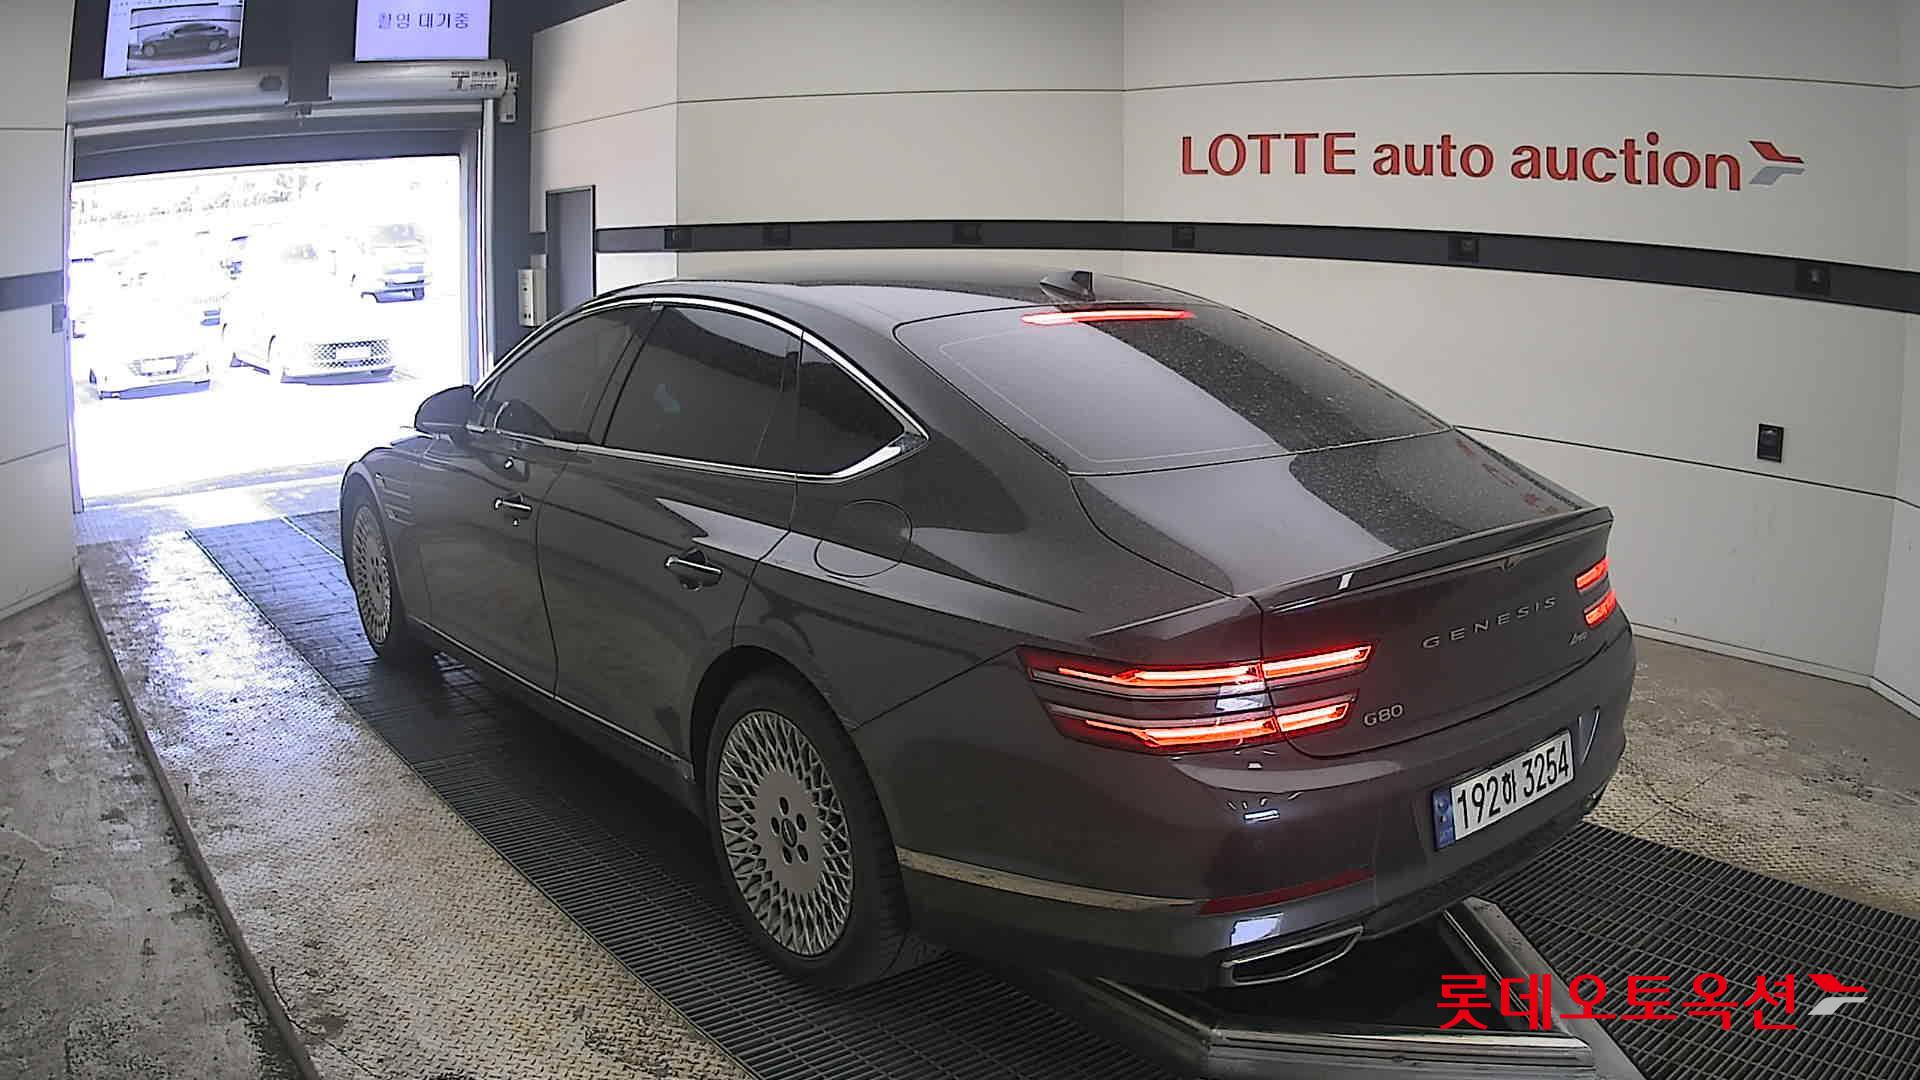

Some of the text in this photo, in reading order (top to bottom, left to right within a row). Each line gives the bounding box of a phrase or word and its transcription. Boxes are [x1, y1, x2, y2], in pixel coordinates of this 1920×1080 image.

[418, 12, 469, 29] 대기중
[1182, 131, 1741, 191] LOTTE auto auction
[1421, 597, 1556, 649] GENESIS
[1363, 703, 1404, 727] G80
[1457, 741, 1569, 829] 192하 3254
